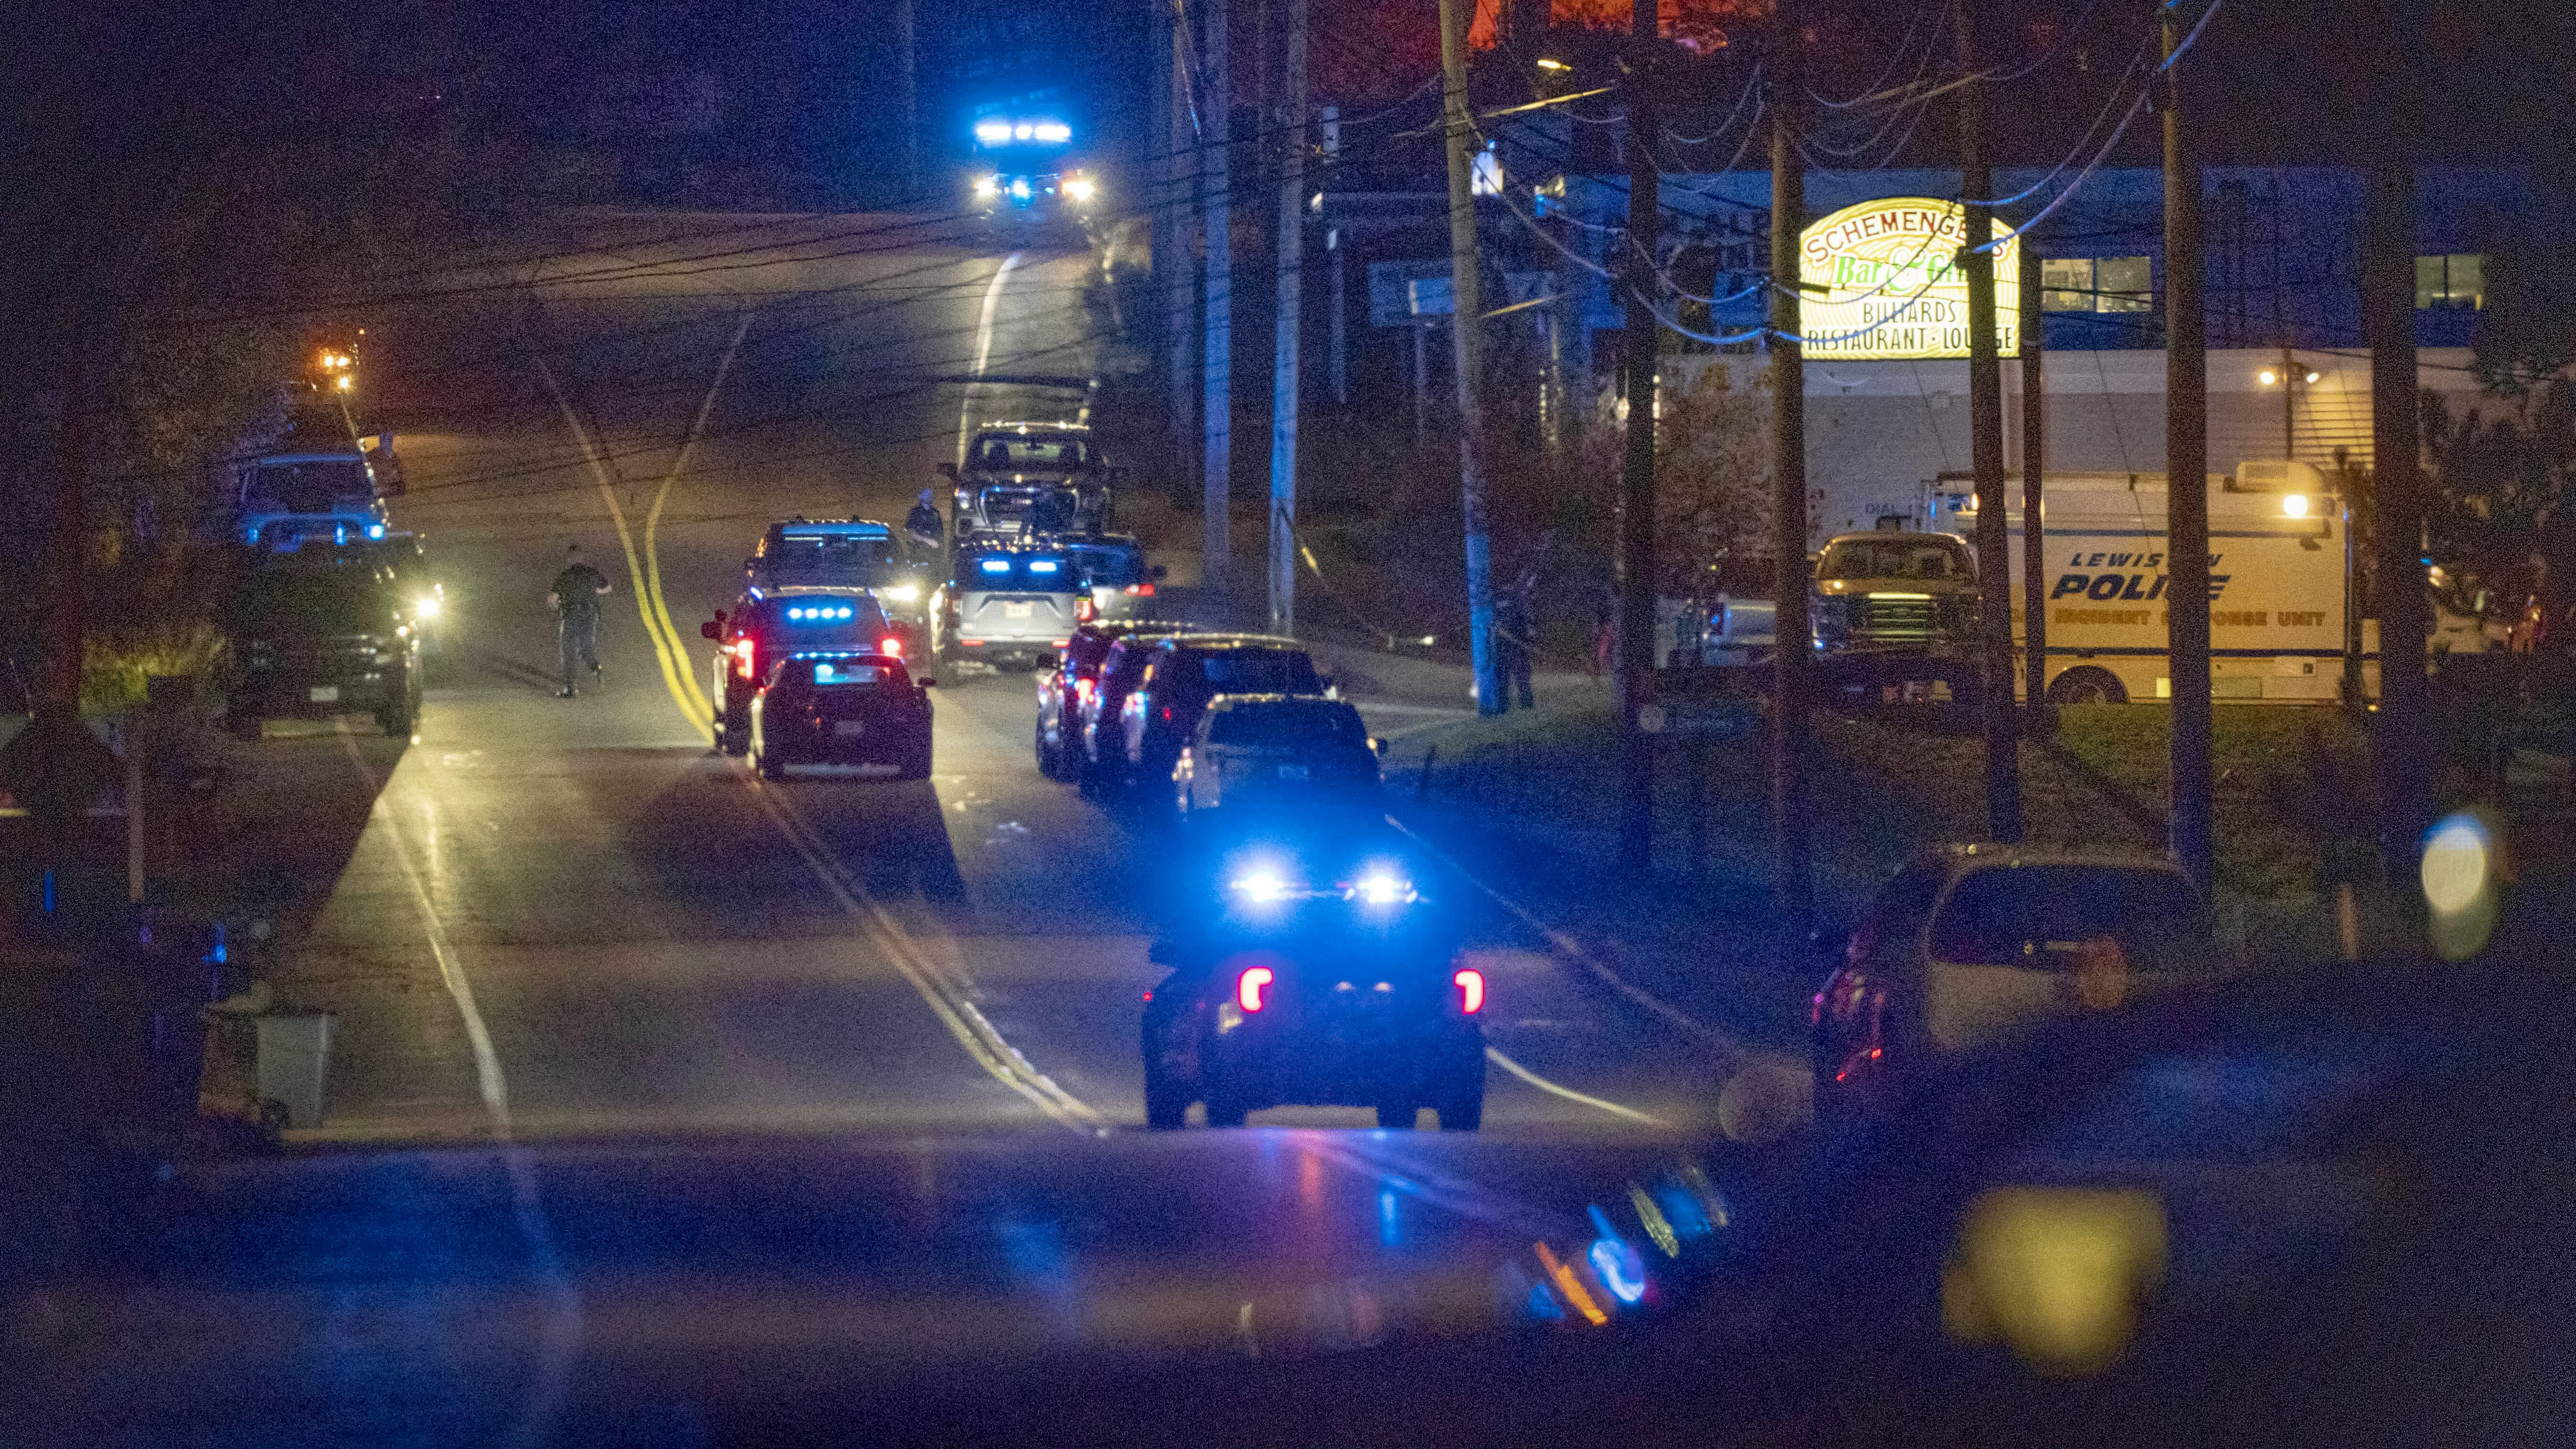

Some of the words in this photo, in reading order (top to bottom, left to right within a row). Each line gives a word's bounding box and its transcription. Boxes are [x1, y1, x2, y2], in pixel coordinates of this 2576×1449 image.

[1834, 257, 1883, 284] Bar
[1886, 247, 1926, 292] &
[1863, 301, 1956, 323] BILLIARDS
[1808, 328, 1926, 350] RESTAURANT
[1944, 327, 2012, 349] LOUGE
[2071, 552, 2223, 568] LEWISN
[2050, 574, 2231, 601] POLIE
[2277, 611, 2326, 626] UNIT
